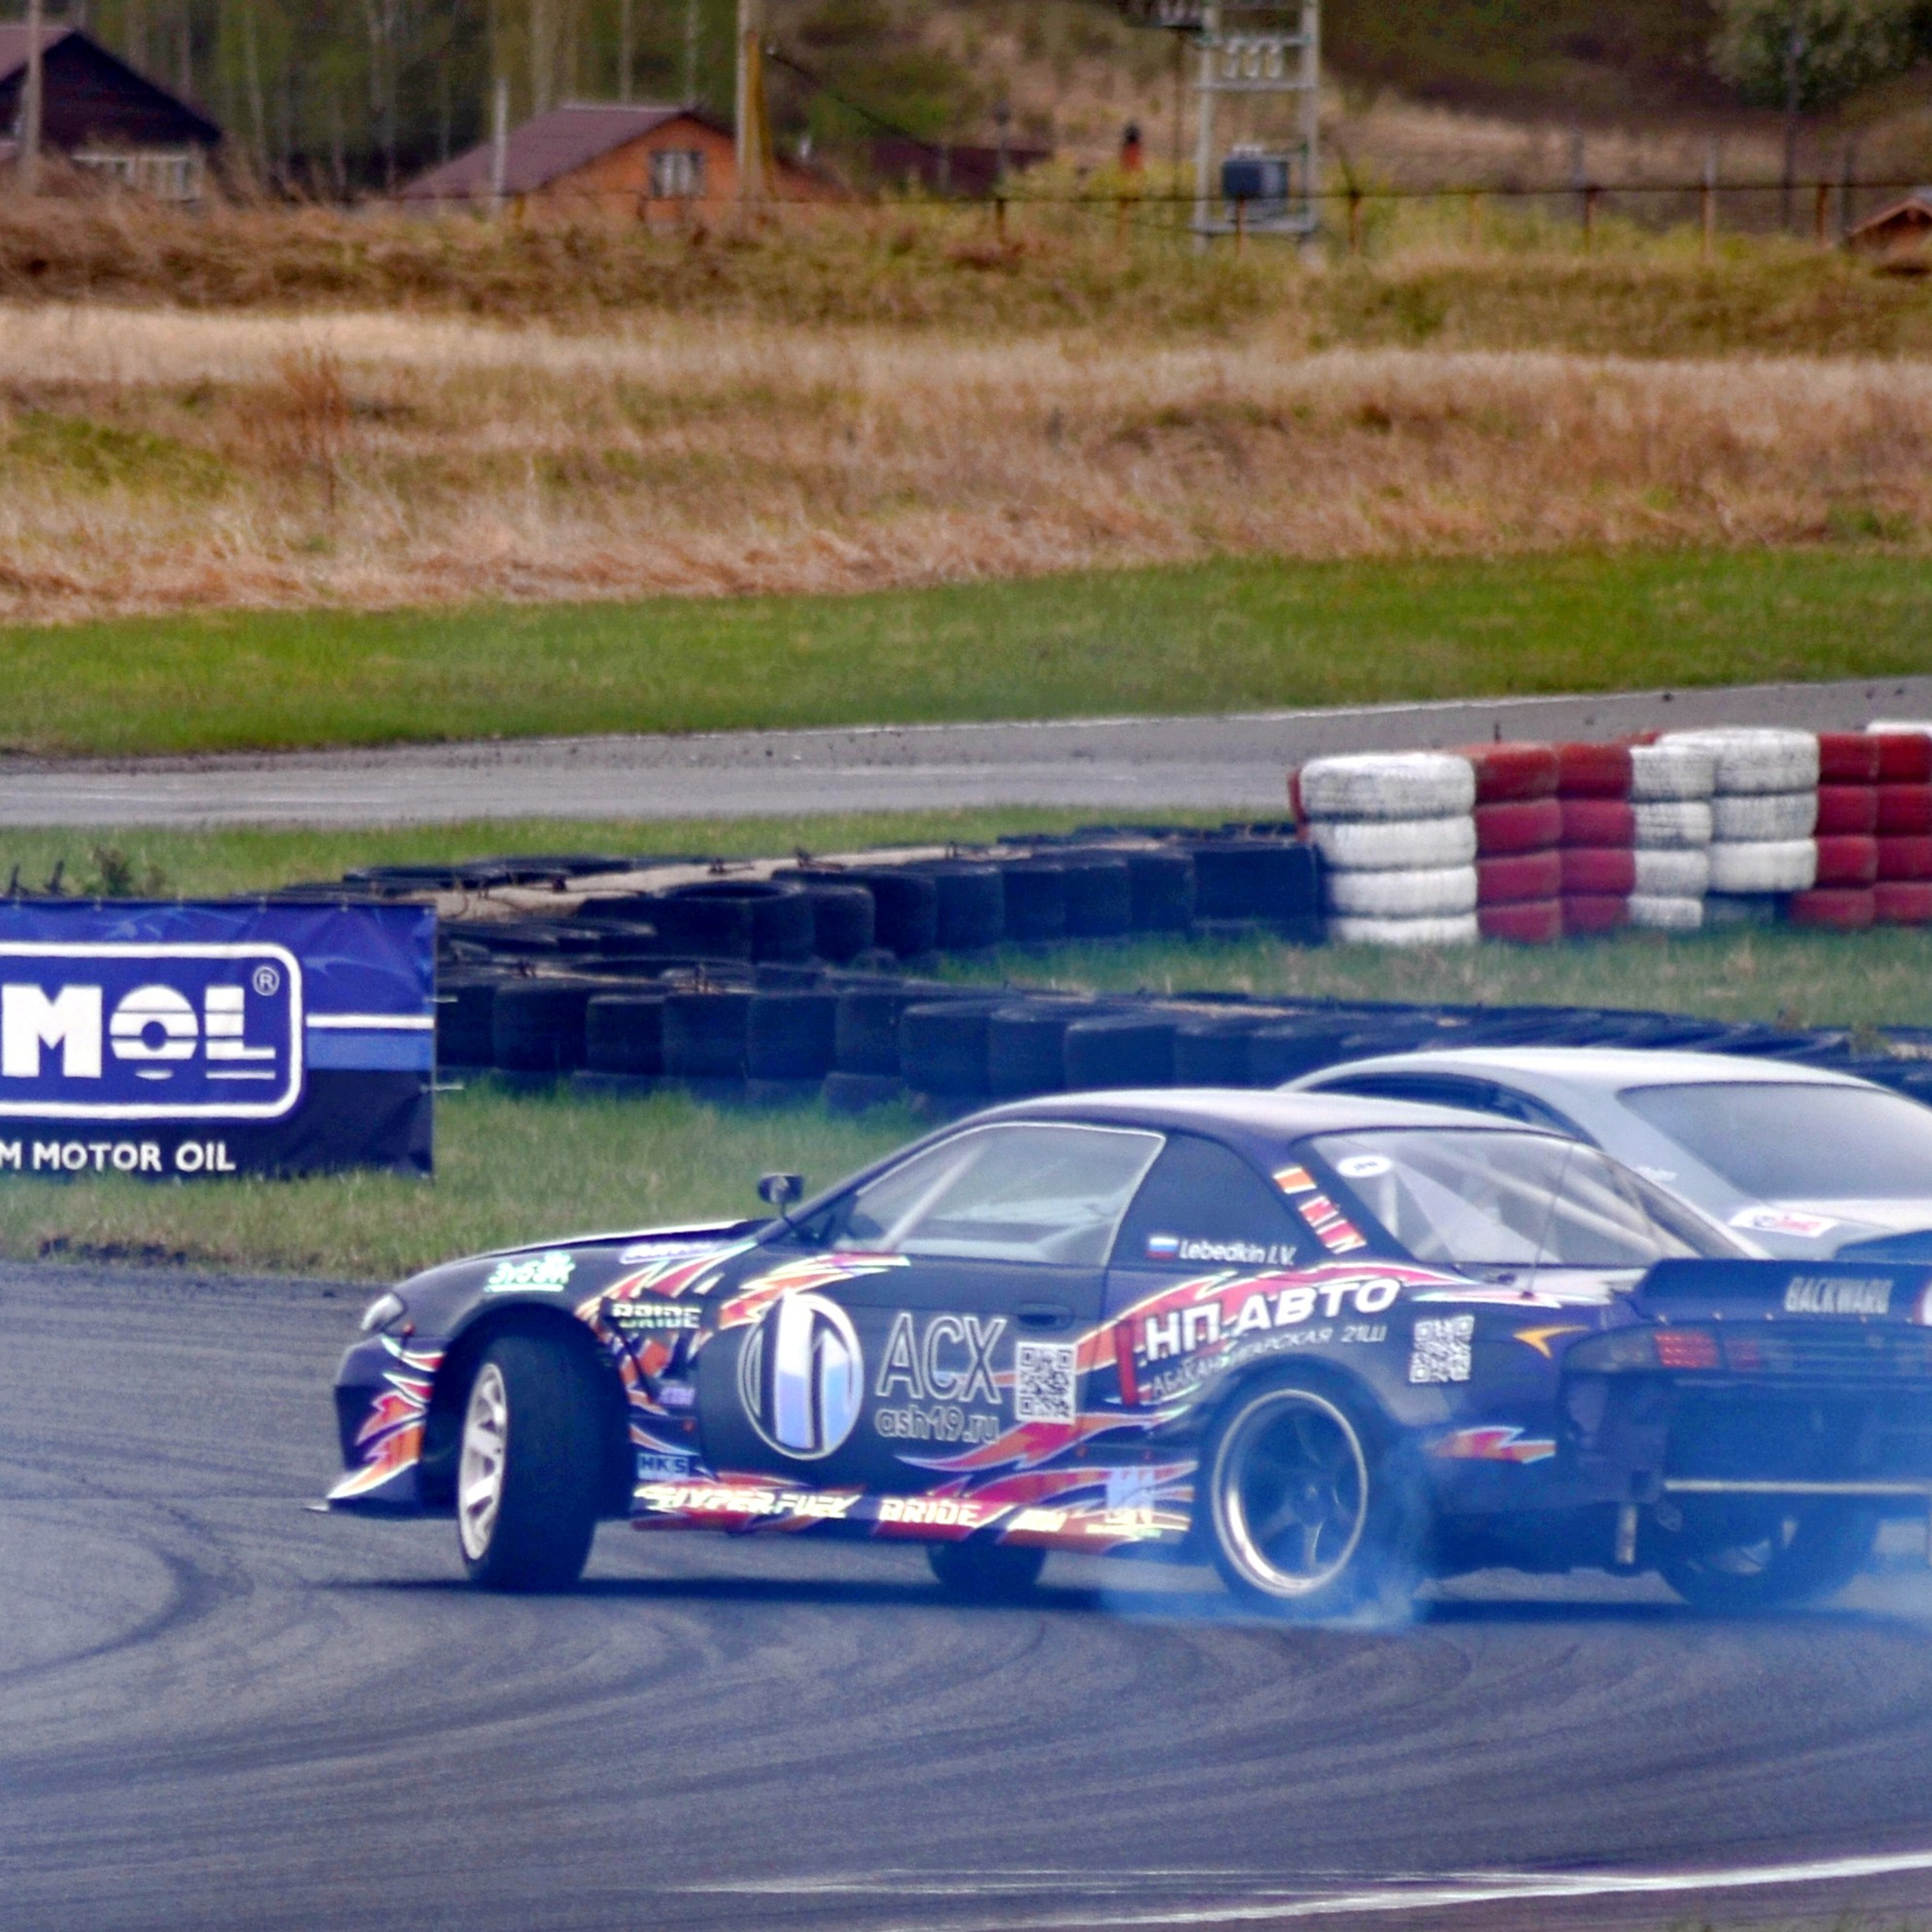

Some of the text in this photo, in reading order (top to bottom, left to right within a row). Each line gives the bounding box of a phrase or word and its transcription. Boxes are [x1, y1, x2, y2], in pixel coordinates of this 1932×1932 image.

[32, 1141, 162, 1172] MOTOR
[175, 1141, 236, 1172] OIL
[640, 1456, 686, 1474] HKS
[878, 1498, 982, 1525] BRIDE
